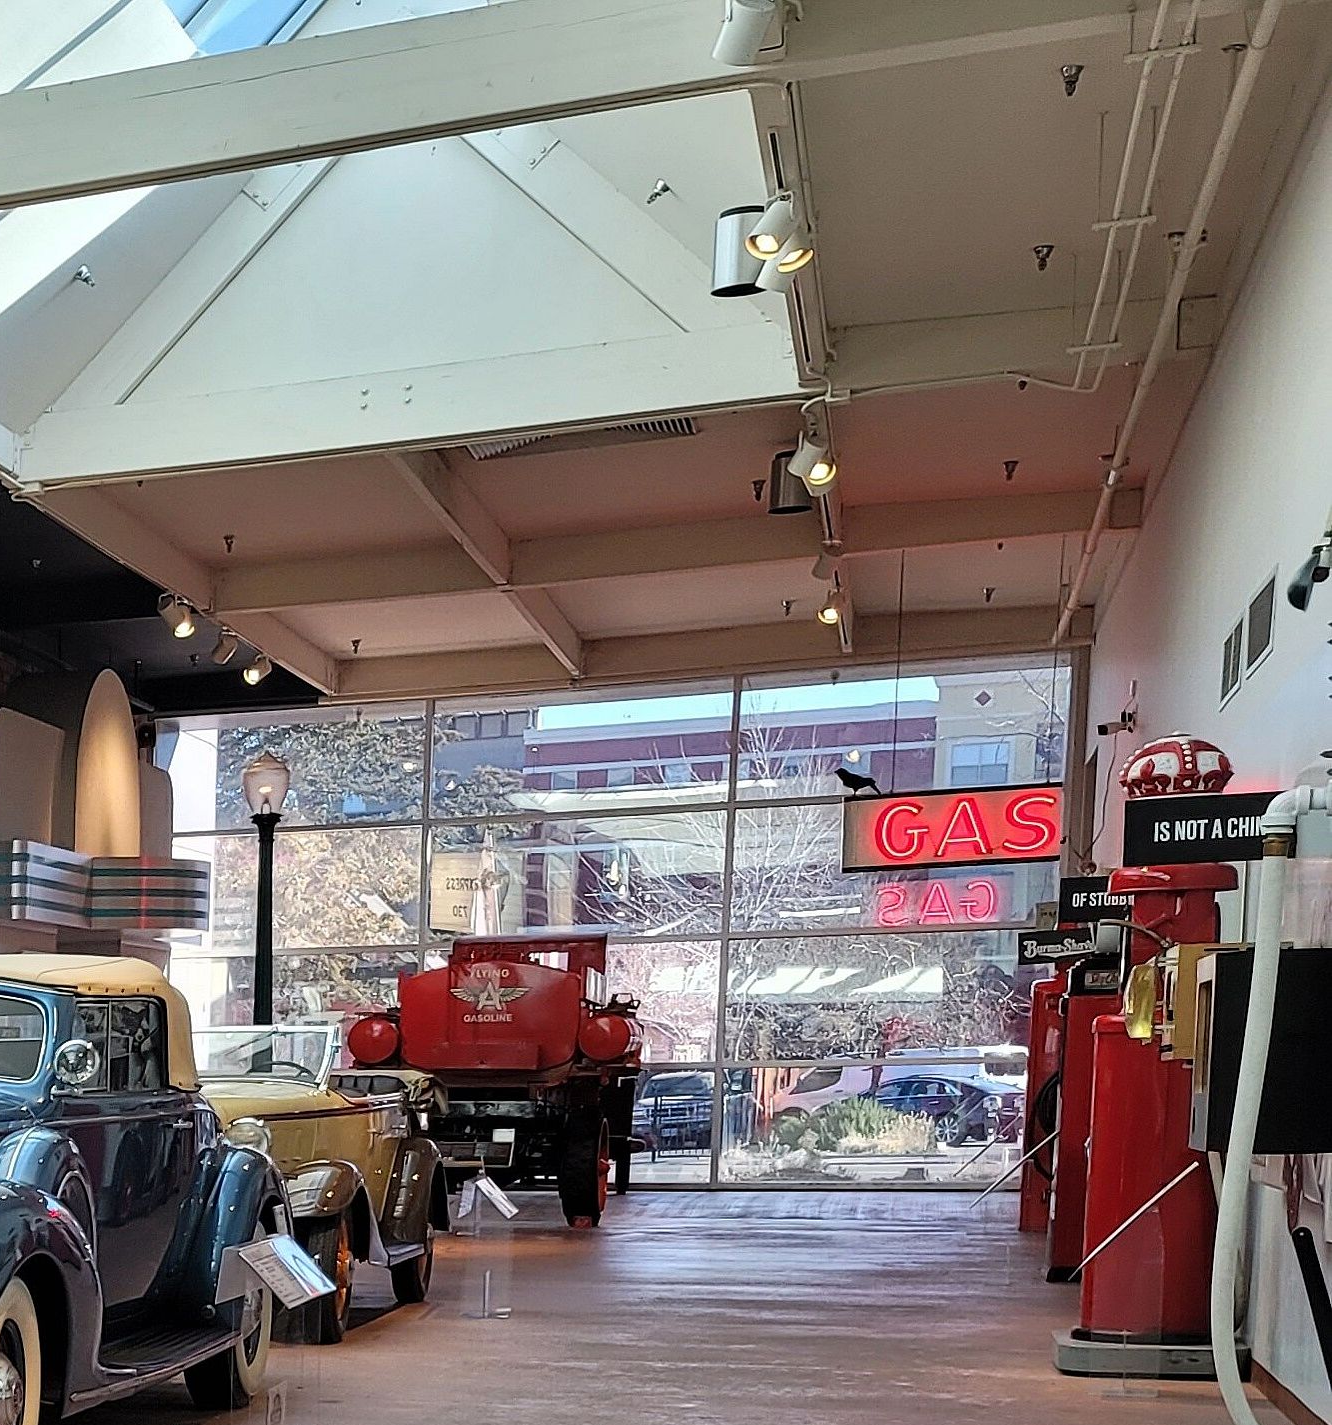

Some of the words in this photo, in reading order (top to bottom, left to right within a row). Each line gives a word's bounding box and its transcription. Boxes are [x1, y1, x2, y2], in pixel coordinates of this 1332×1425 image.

[875, 793, 1057, 861] GAS
[1154, 821, 1171, 842] IS
[1174, 819, 1209, 842] NOT
[1211, 818, 1223, 839] A
[1072, 893, 1088, 907] OF
[1023, 938, 1095, 958] Burma-Shav
[463, 1013, 514, 1023] GASOLINE
